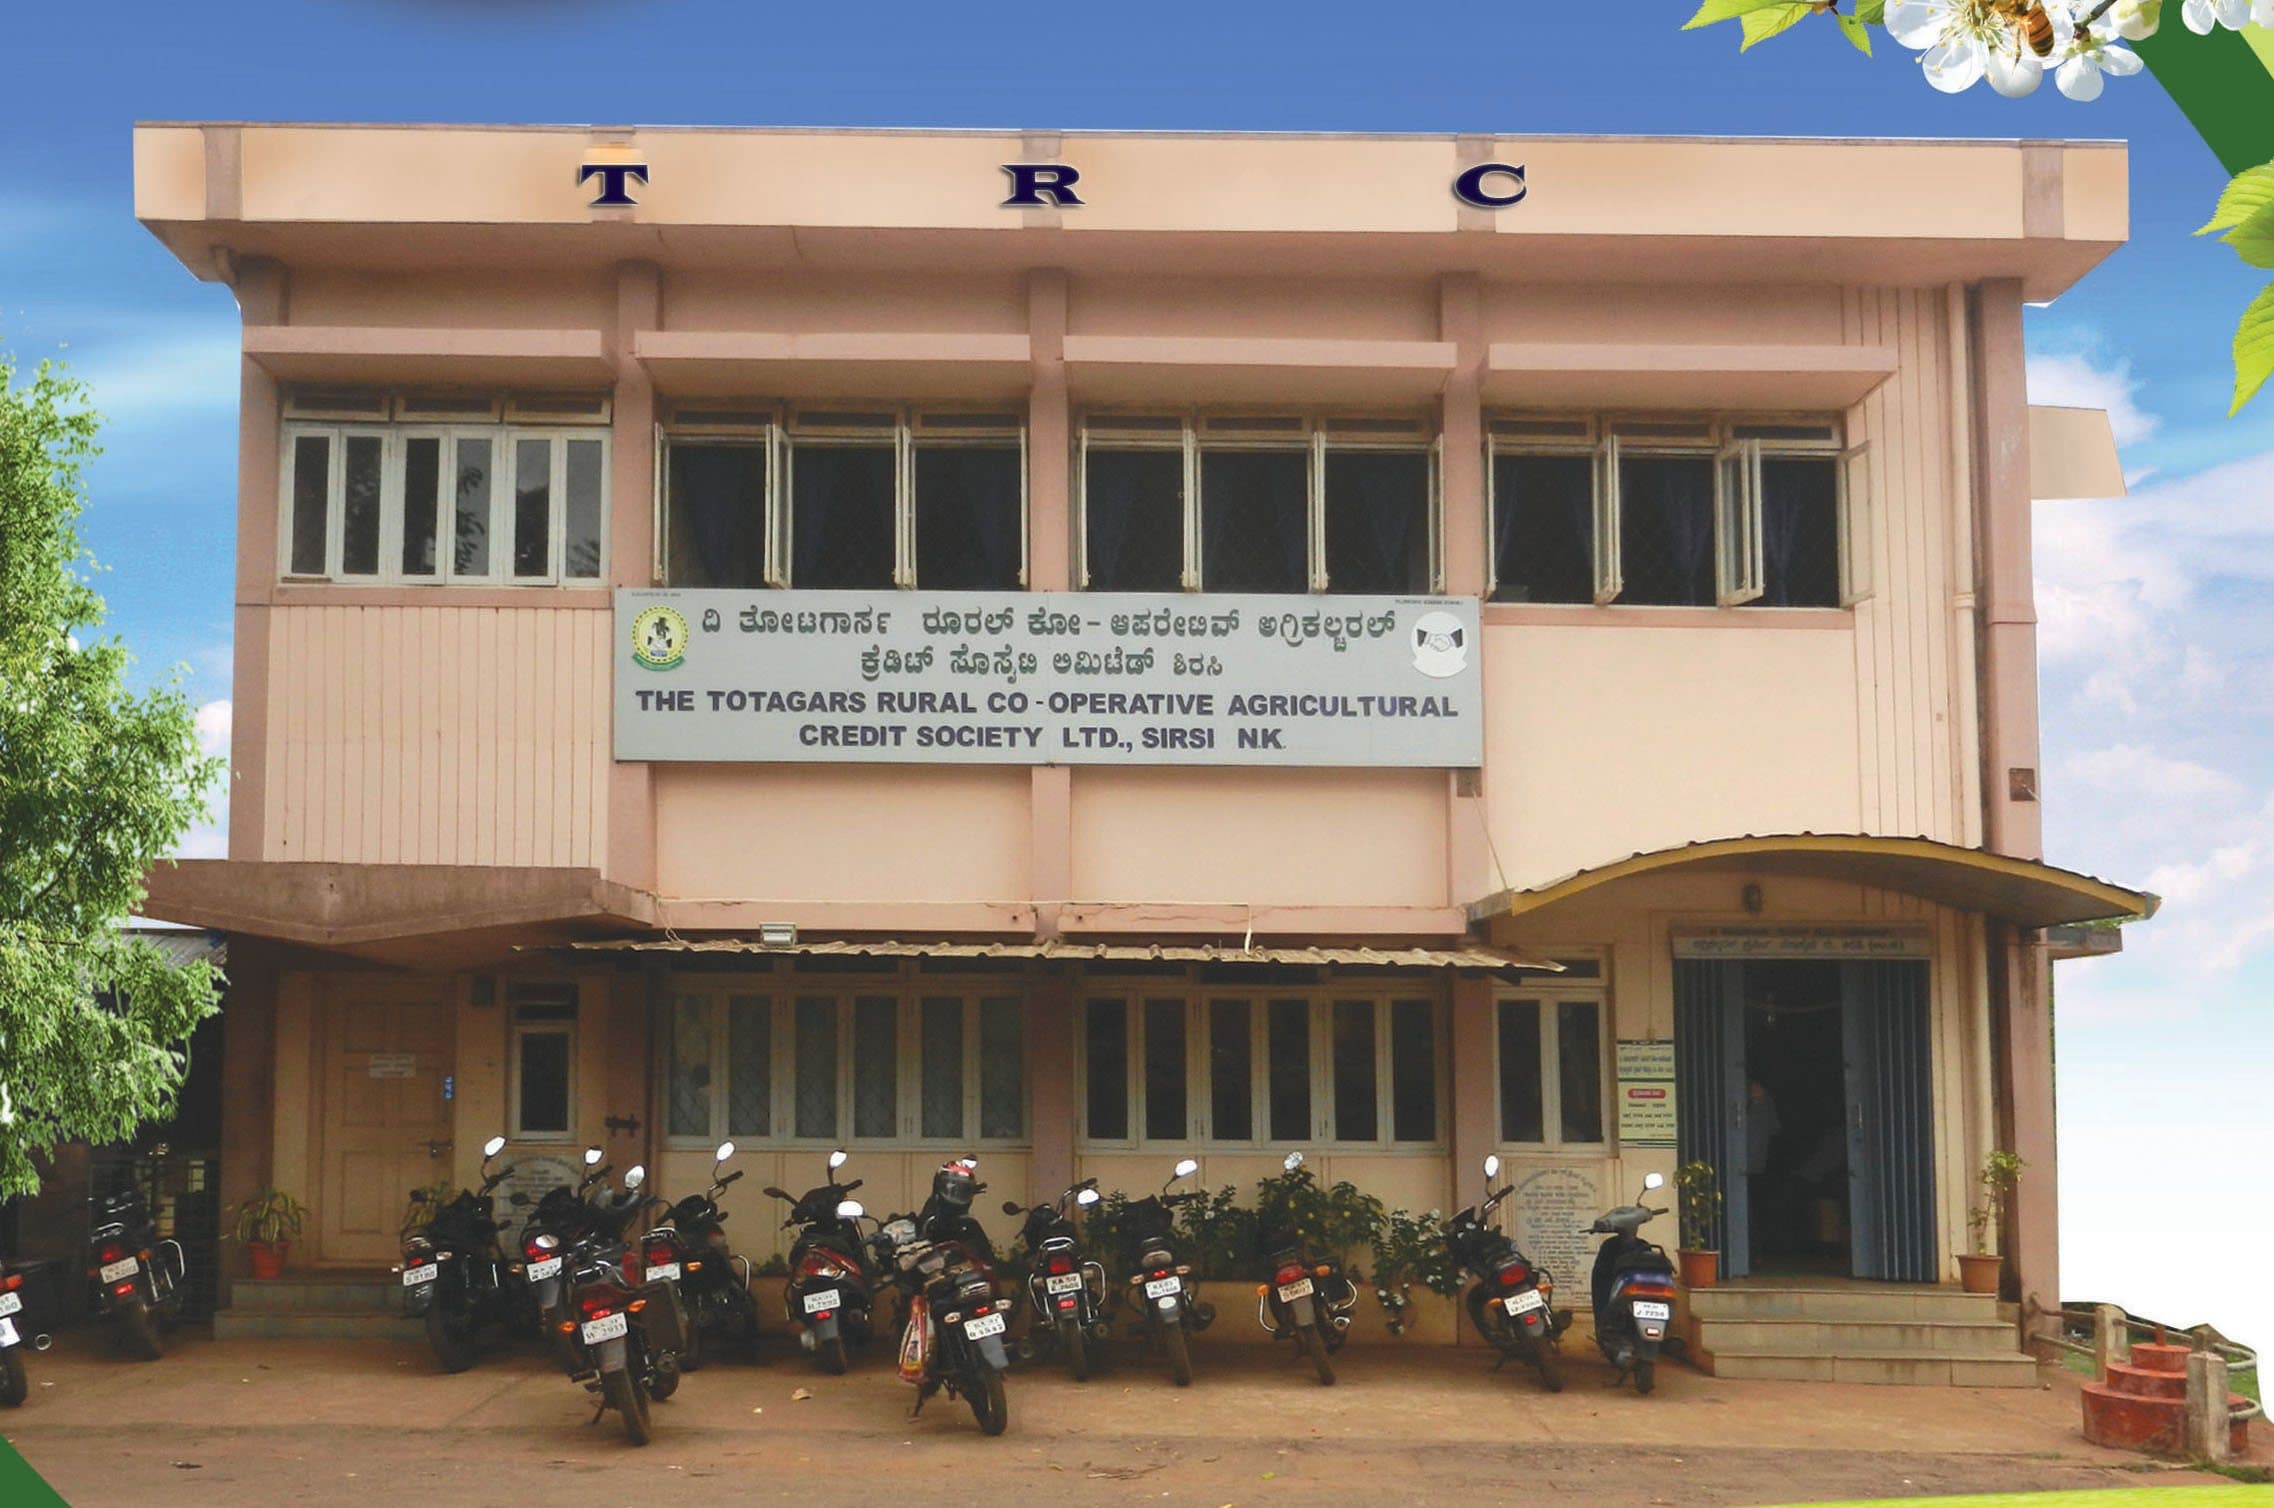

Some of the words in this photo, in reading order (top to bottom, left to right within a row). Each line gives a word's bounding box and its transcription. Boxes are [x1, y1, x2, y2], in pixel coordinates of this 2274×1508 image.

[701, 608, 721, 633] ದಿ
[922, 606, 1014, 635] ರೂರಲ್
[861, 644, 934, 682] ಕ್ರೆಡಿಟ್
[1053, 646, 1154, 675] ಲಿಮಿಟೆಡ್
[1173, 652, 1223, 676] ಶಿರಸಿ
[635, 690, 695, 712] THE
[706, 690, 867, 714] TOTAGARS
[877, 691, 977, 714] RURAL
[1228, 694, 1459, 718] AGRICULTURAL
[799, 724, 907, 747] CREDIT
[916, 725, 1043, 748] SOCIETY
[1062, 727, 1133, 753] LTD.,
[1142, 727, 1215, 749] SIRSI
